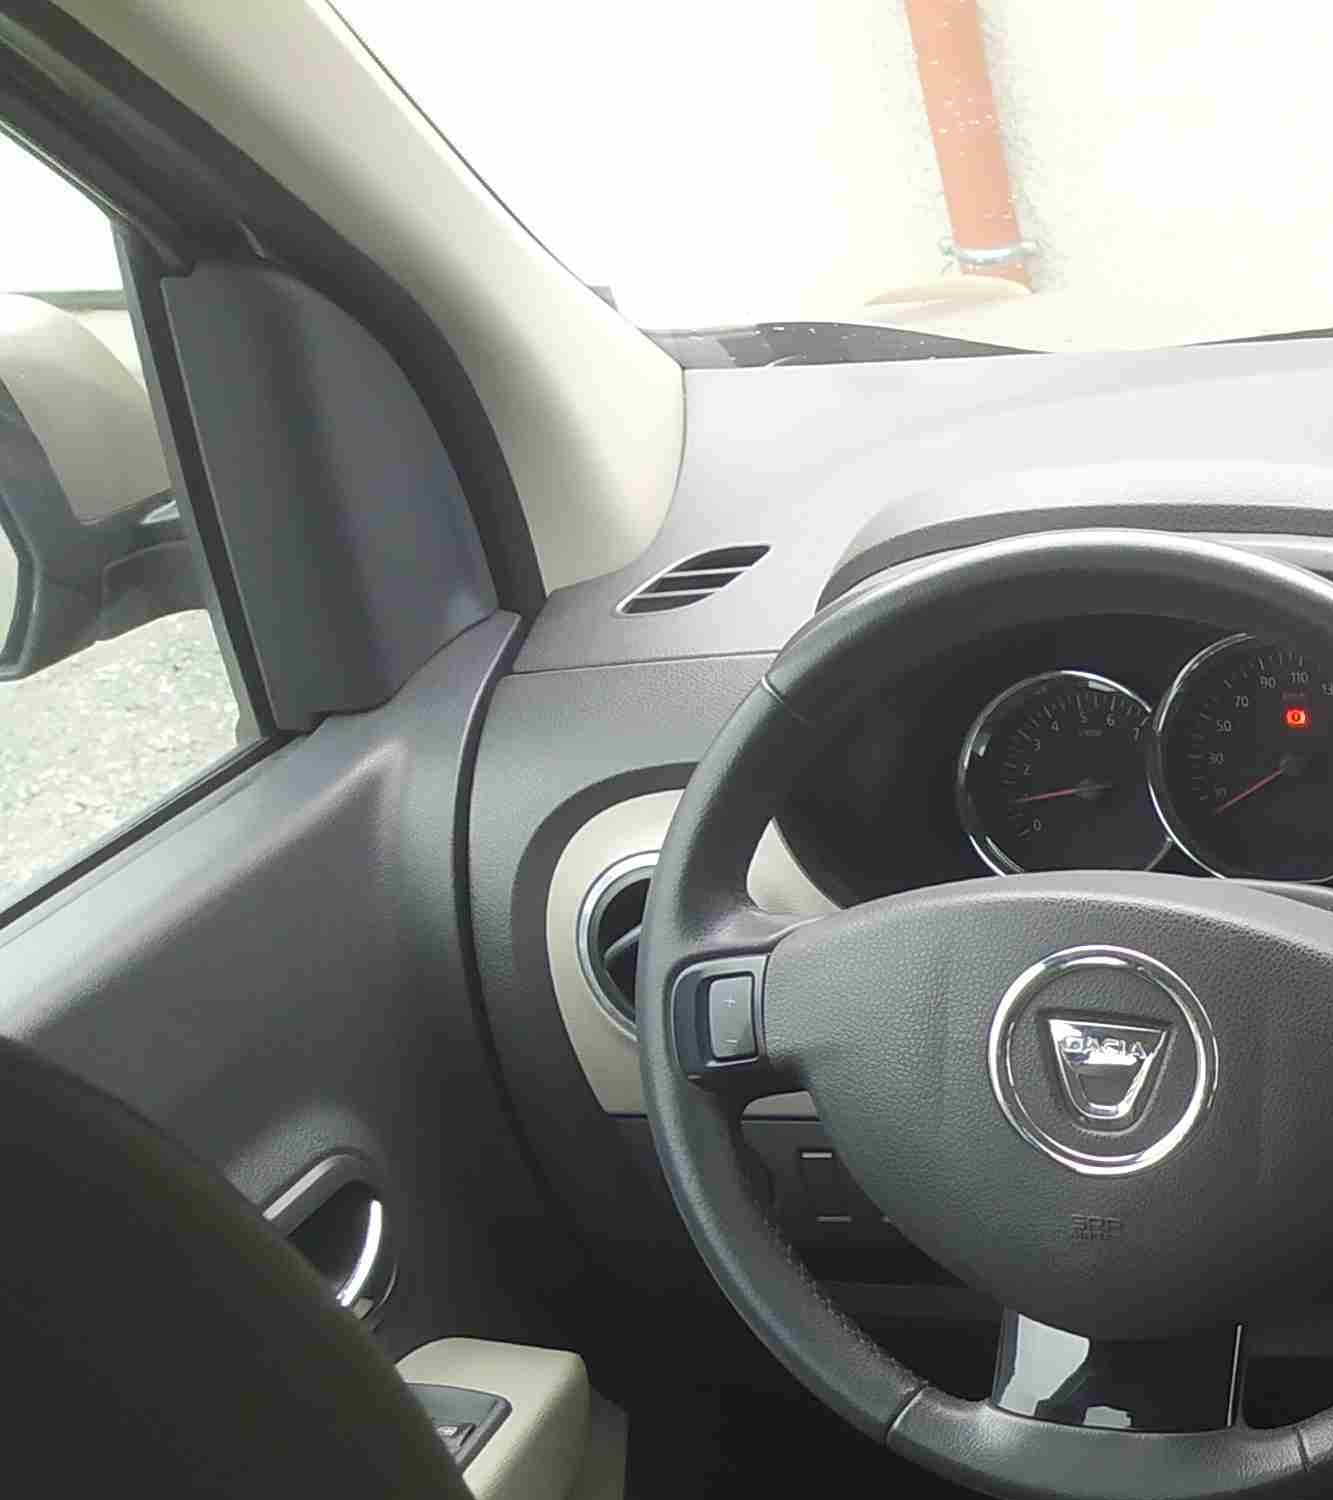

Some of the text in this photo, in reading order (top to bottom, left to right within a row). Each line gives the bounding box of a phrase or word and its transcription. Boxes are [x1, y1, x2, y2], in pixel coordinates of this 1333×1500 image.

[1234, 695, 1249, 708] 70
[1051, 720, 1061, 732] 4
[1106, 714, 1115, 727] 6
[1216, 719, 1232, 732] 50
[1033, 738, 1041, 752] 3
[1023, 763, 1032, 777] 2
